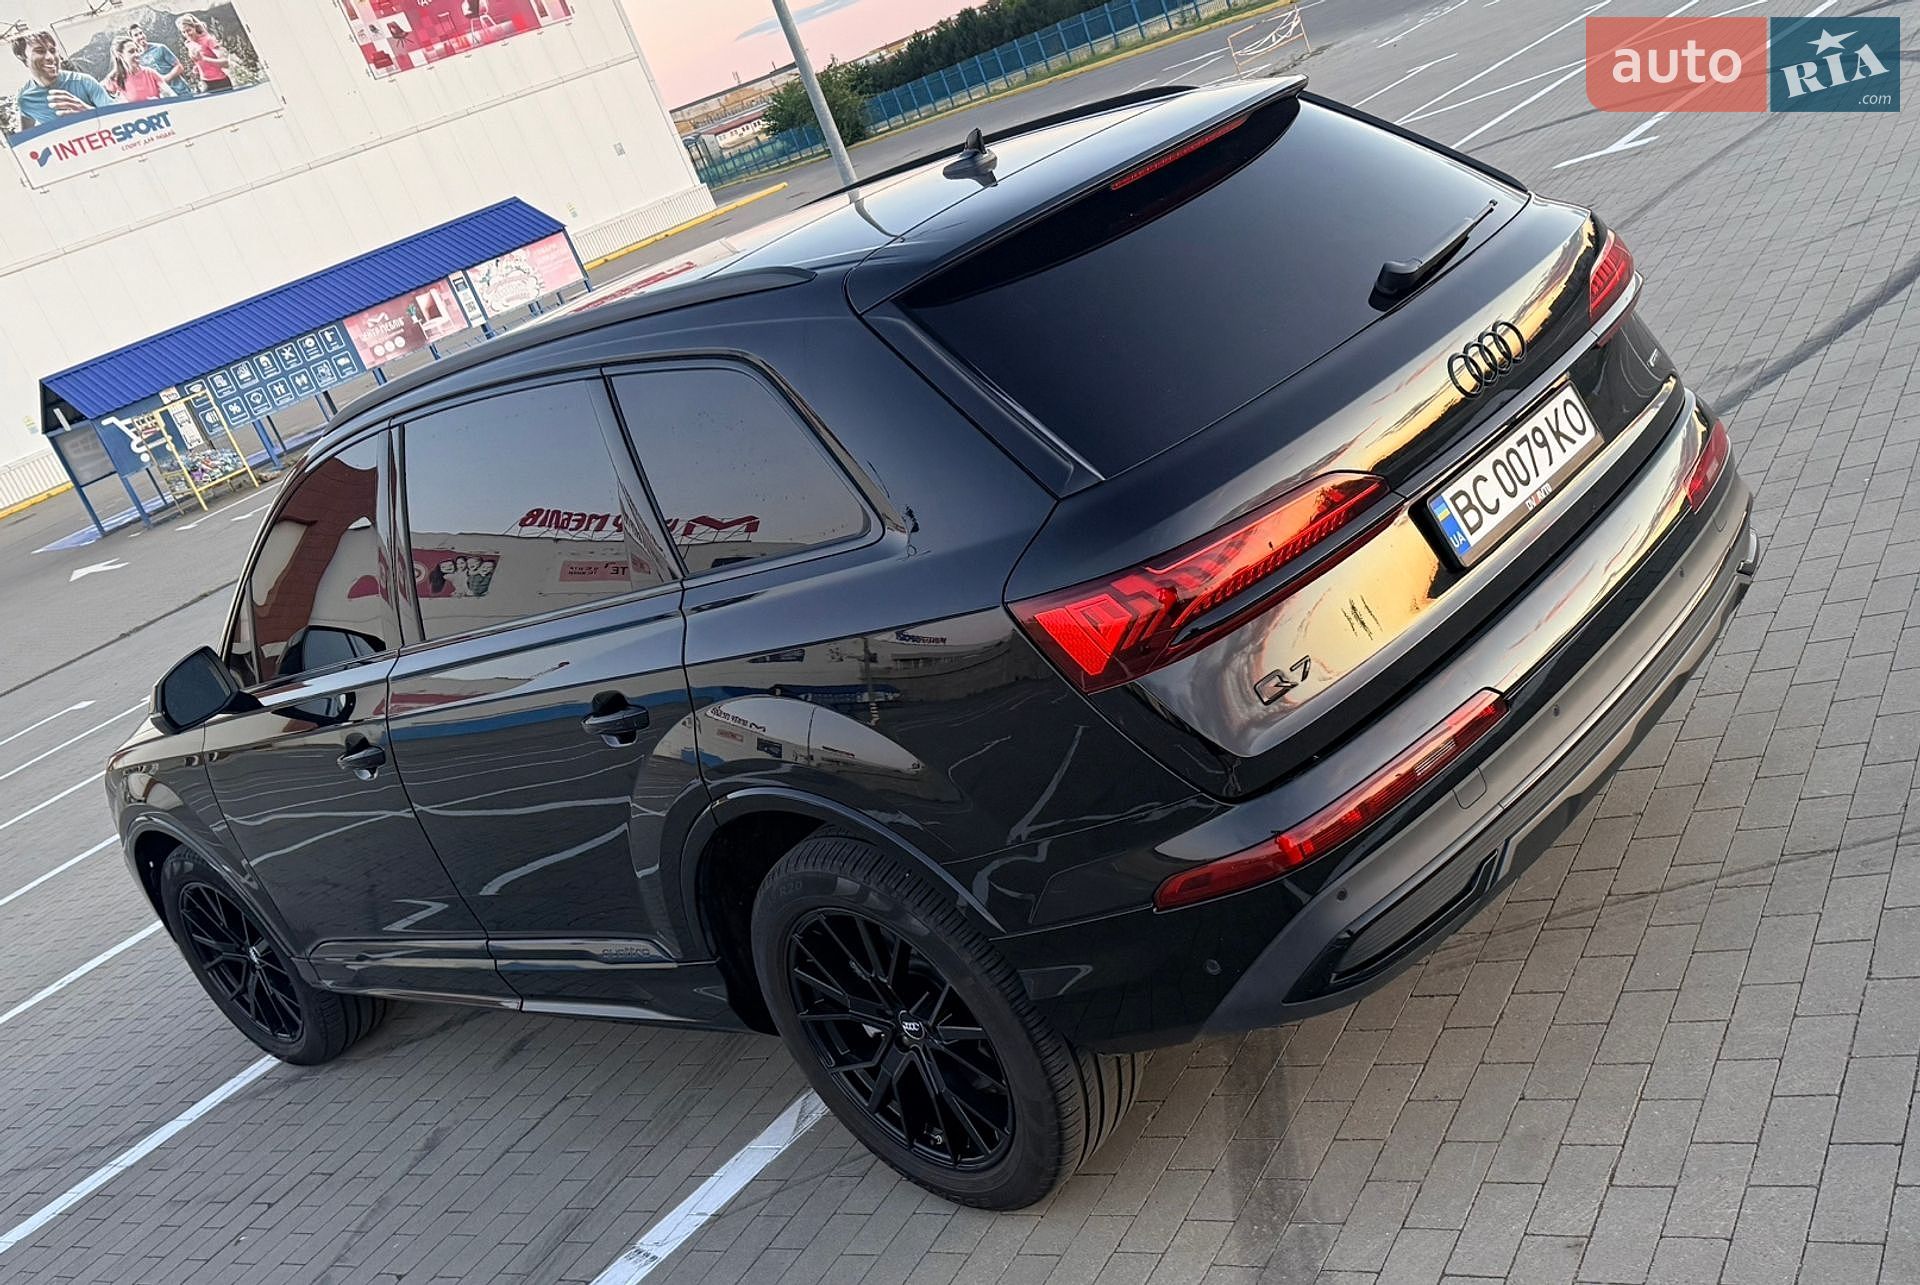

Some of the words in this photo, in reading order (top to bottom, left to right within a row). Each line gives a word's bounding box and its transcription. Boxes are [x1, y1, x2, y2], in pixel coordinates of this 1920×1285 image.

[53, 111, 173, 162] INTERSPORT
[1544, 398, 1587, 454] KO
[1491, 426, 1554, 498] 0079
[1449, 474, 1500, 536] BC
[1450, 535, 1466, 548] UA
[1253, 655, 1311, 706] Q7
